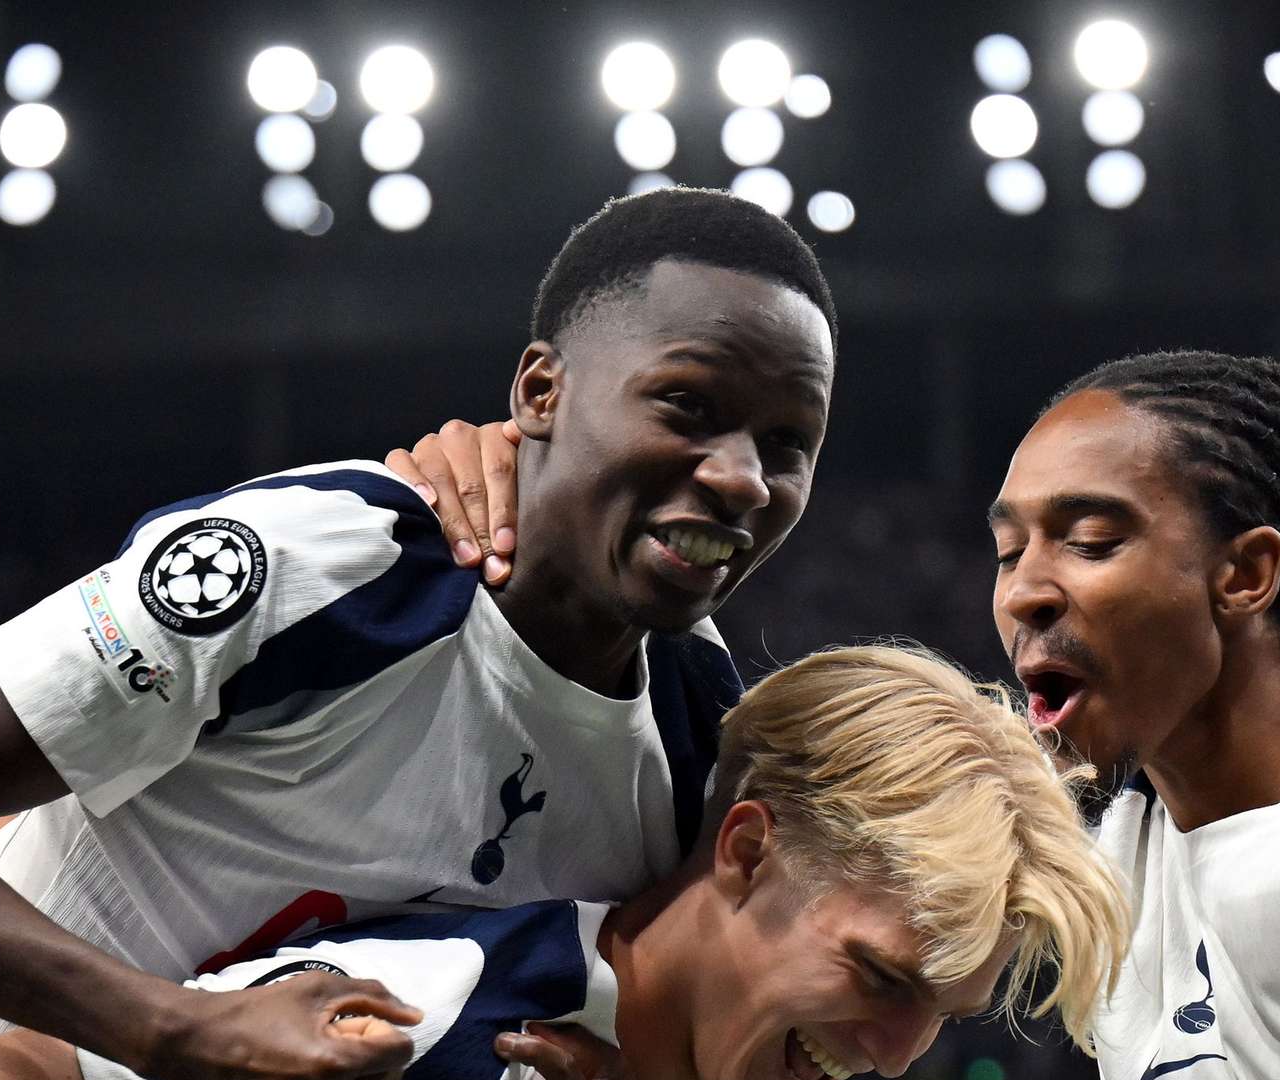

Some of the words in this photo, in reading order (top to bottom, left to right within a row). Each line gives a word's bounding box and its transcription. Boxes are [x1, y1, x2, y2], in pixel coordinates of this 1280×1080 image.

[203, 520, 230, 528] UEFA
[230, 523, 260, 551] EUROPA
[248, 551, 264, 593] LEAGUE
[141, 572, 151, 594] 2025
[144, 592, 184, 628] WINNERS
[118, 648, 156, 693] 10
[304, 962, 330, 972] UEFA
